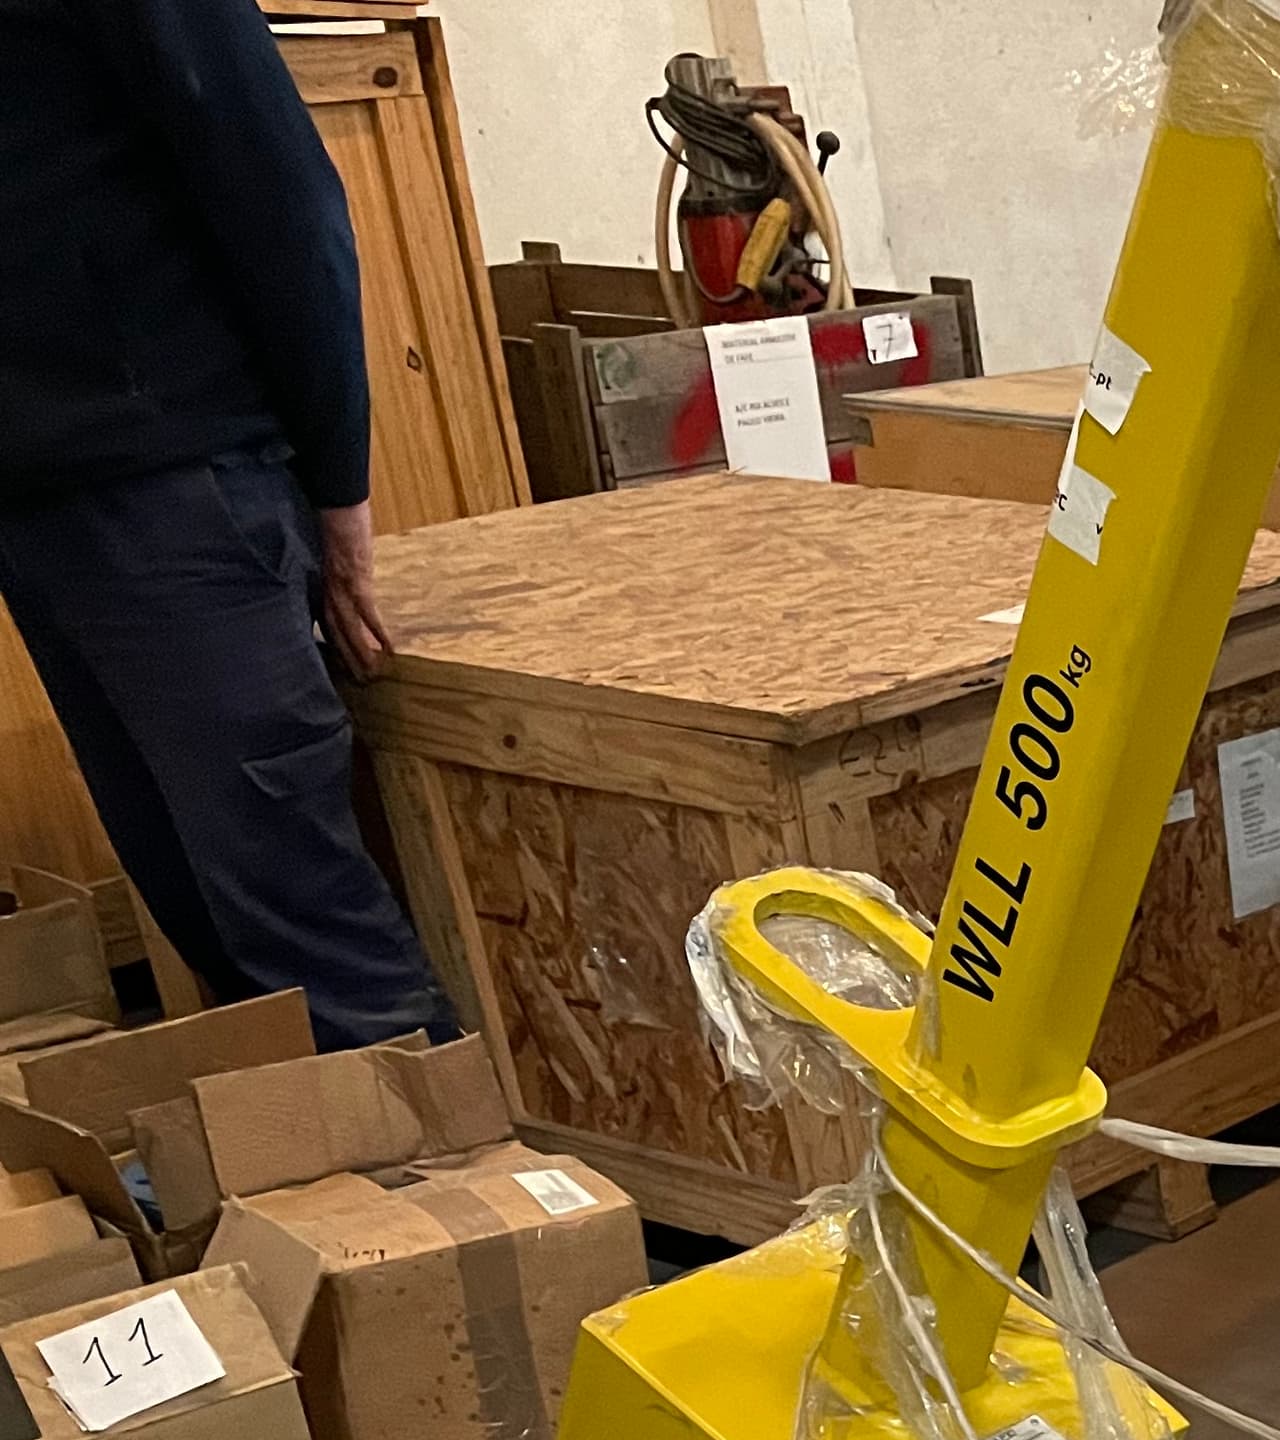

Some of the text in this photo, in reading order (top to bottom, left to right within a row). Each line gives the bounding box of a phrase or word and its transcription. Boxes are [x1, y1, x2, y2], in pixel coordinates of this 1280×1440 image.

[875, 322, 895, 359] 7
[943, 644, 1092, 1003] WLL 500 kg
[82, 1317, 163, 1387] 11
